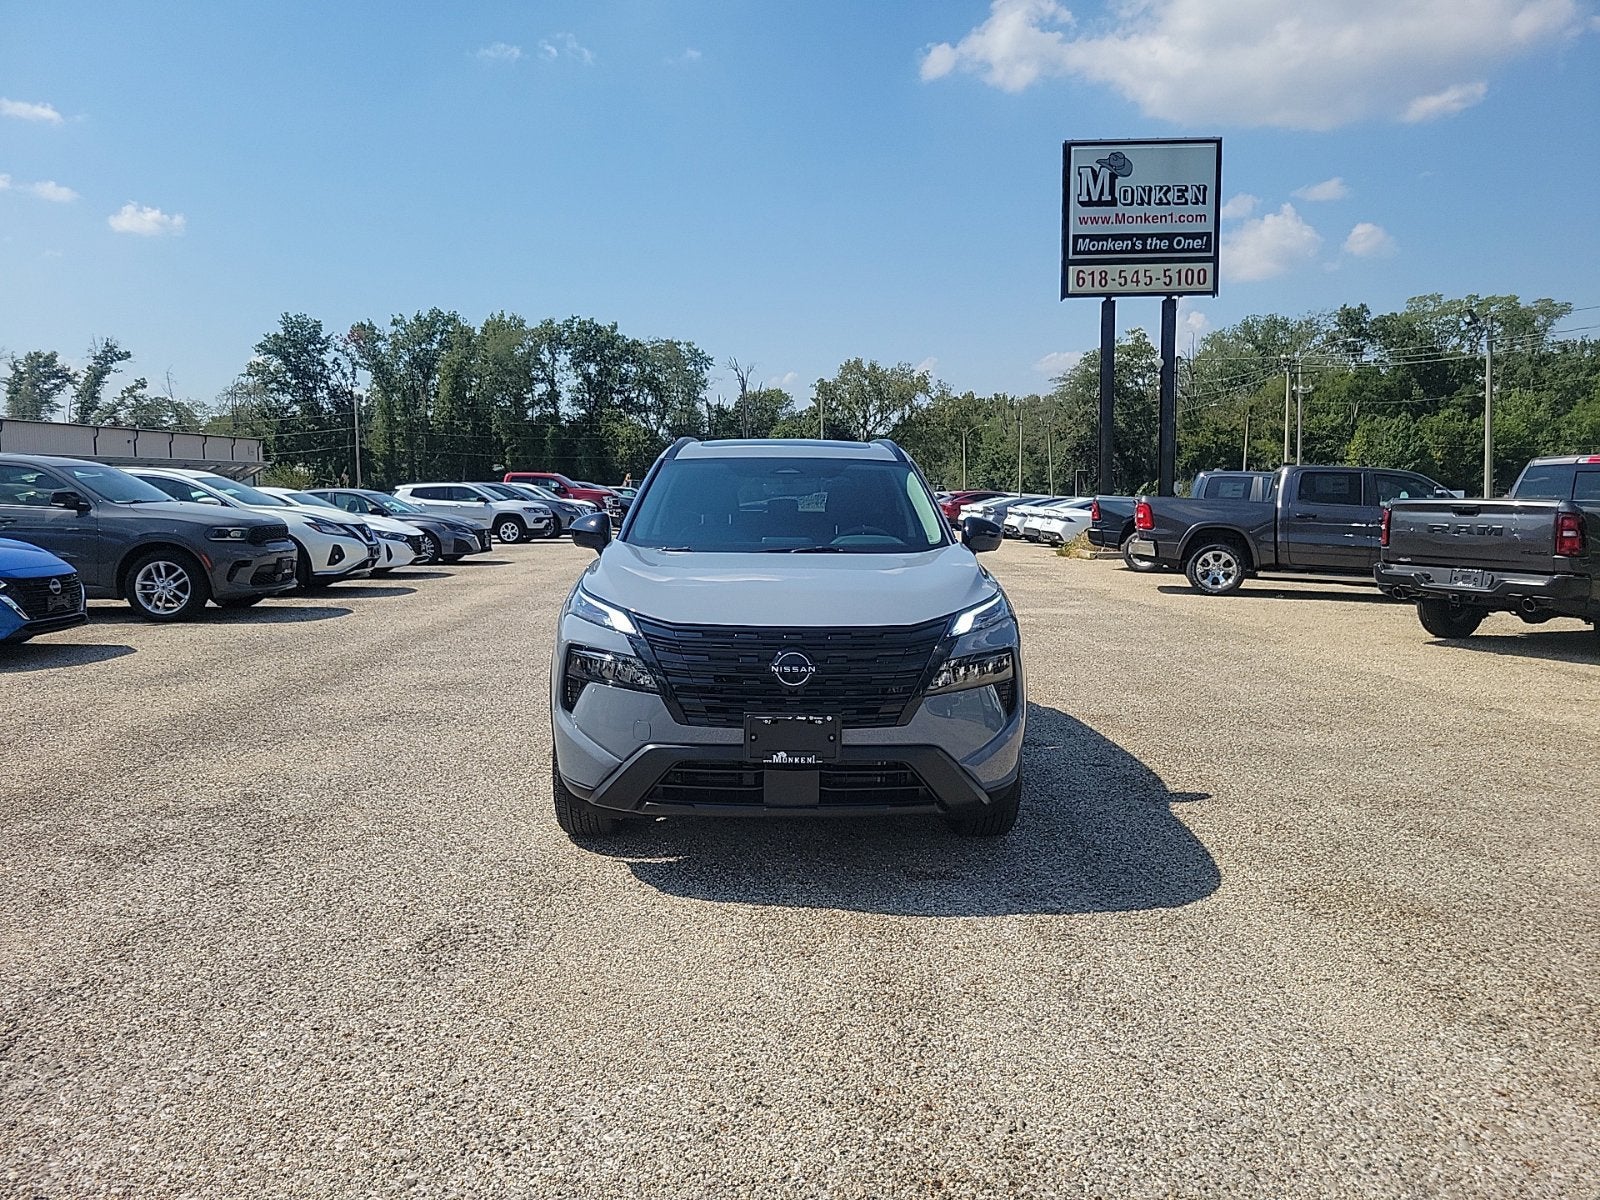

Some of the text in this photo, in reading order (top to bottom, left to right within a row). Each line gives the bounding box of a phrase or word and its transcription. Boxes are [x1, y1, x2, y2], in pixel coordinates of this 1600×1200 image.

[1078, 166, 1207, 207] MONKEN
[1078, 212, 1207, 225] www.Monken1.com
[1077, 236, 1207, 251] Monken's the One!
[1075, 268, 1207, 287] 618-545-5100
[1427, 523, 1503, 537] RAM
